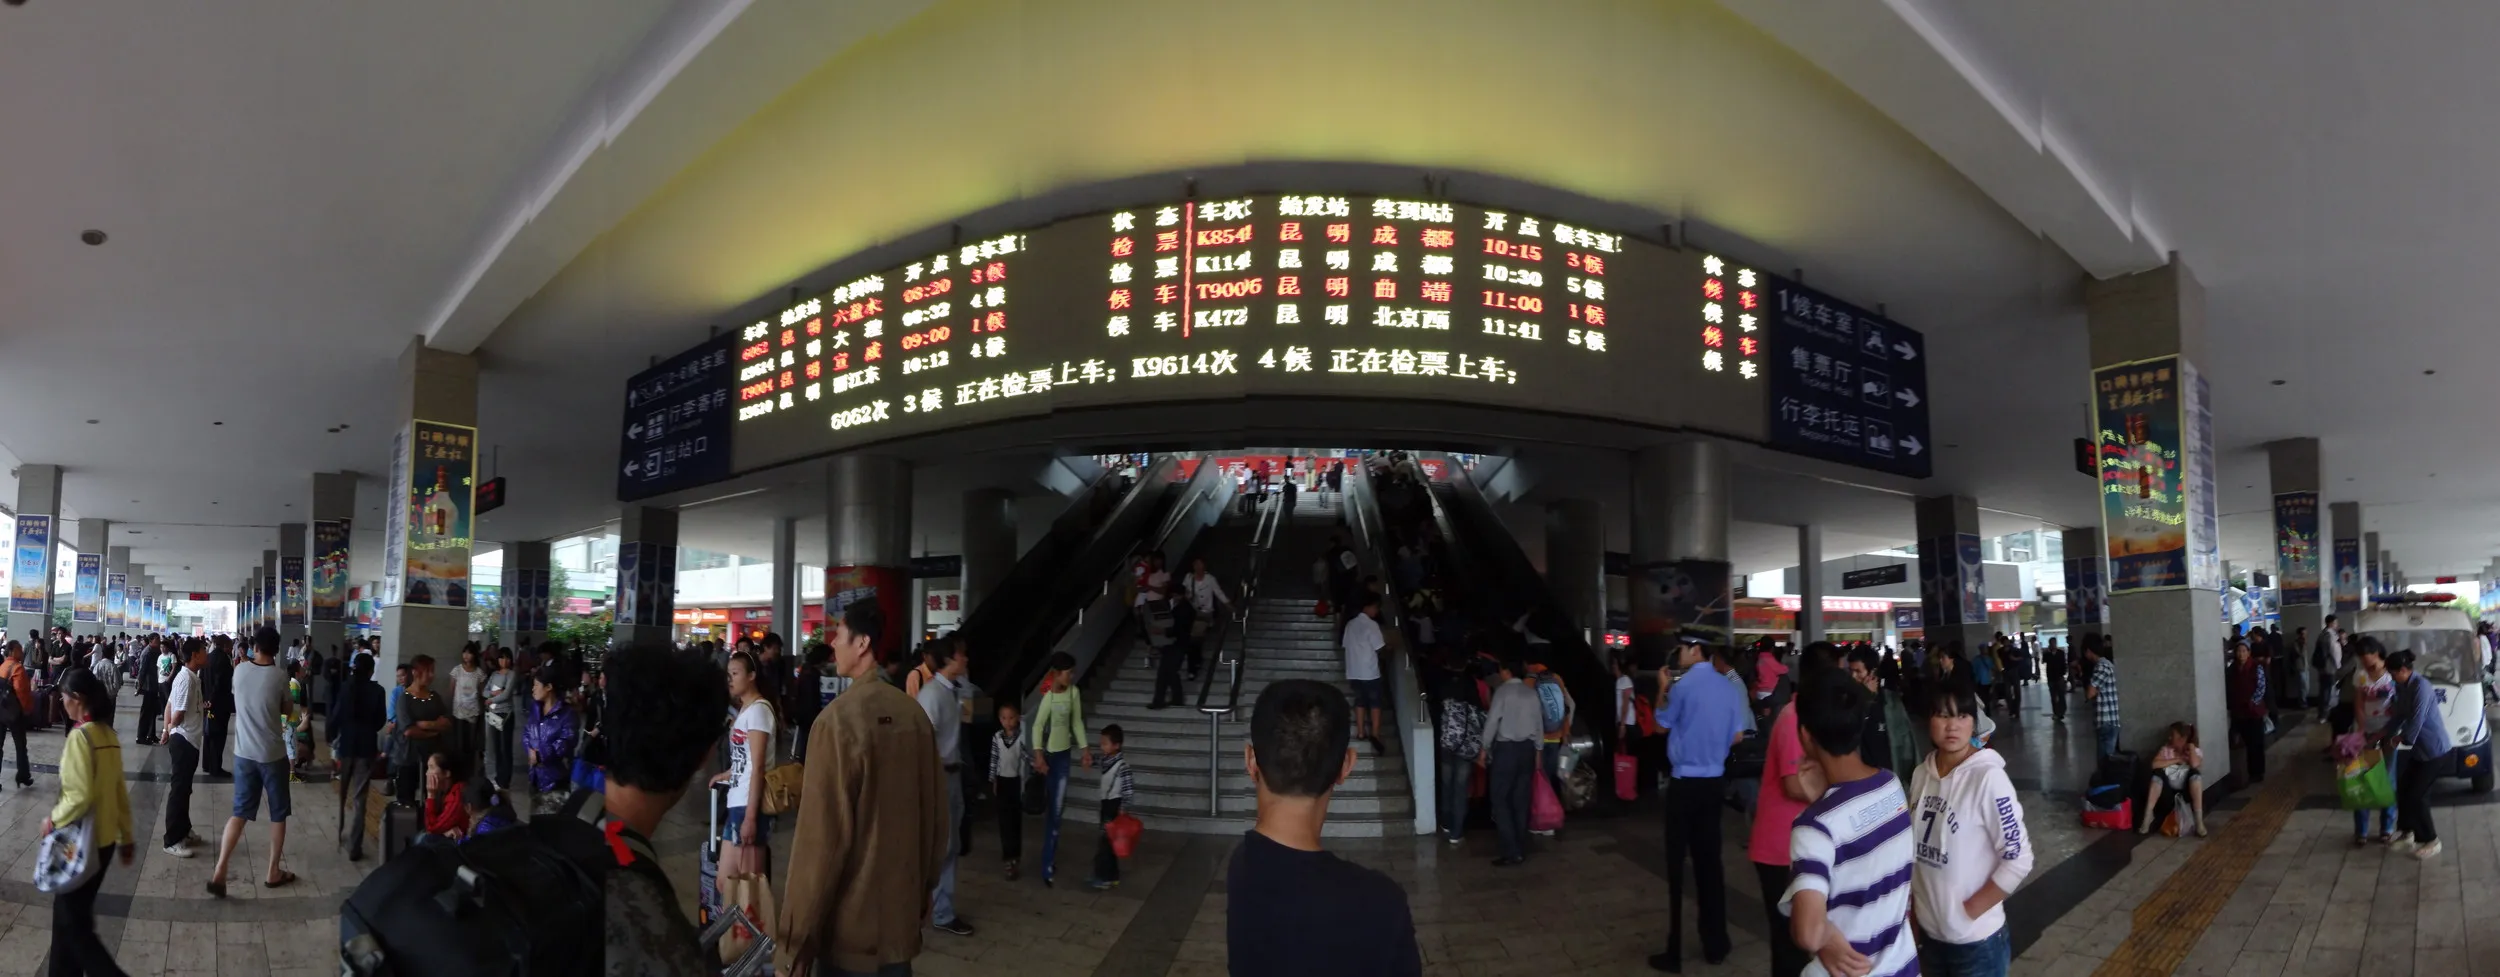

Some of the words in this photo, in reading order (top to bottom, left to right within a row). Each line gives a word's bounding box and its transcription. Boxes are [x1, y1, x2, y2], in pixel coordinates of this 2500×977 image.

[1279, 196, 1349, 216] 始发站
[1484, 212, 1540, 237] 开点
[1280, 223, 1350, 242] 昆明
[1372, 226, 1454, 248] 成都
[1484, 239, 1542, 261] 10:15
[1567, 253, 1603, 275] 3候
[1278, 249, 1349, 270] 昆明
[1371, 252, 1453, 274] 成都
[1483, 264, 1543, 287] 10:30
[1567, 277, 1604, 300] 5候
[1278, 276, 1348, 296] 昆明
[1374, 279, 1452, 302] 曲靖
[1483, 291, 1543, 312] 11:00
[1570, 304, 1605, 325] 1候
[1777, 288, 1854, 335] 1候车室
[902, 326, 950, 350] 09:00
[1276, 304, 1348, 325] 昆明
[1373, 306, 1450, 329] 北京西
[1483, 318, 1542, 340] 11:41
[1568, 329, 1606, 351] 5候
[903, 351, 949, 374] 10:12
[1790, 345, 1852, 383] 售票厅
[668, 388, 727, 424] 行李寄存
[1780, 396, 1861, 437] 行李托运
[664, 436, 707, 463] 出站口
[1922, 810, 1937, 844] 7
